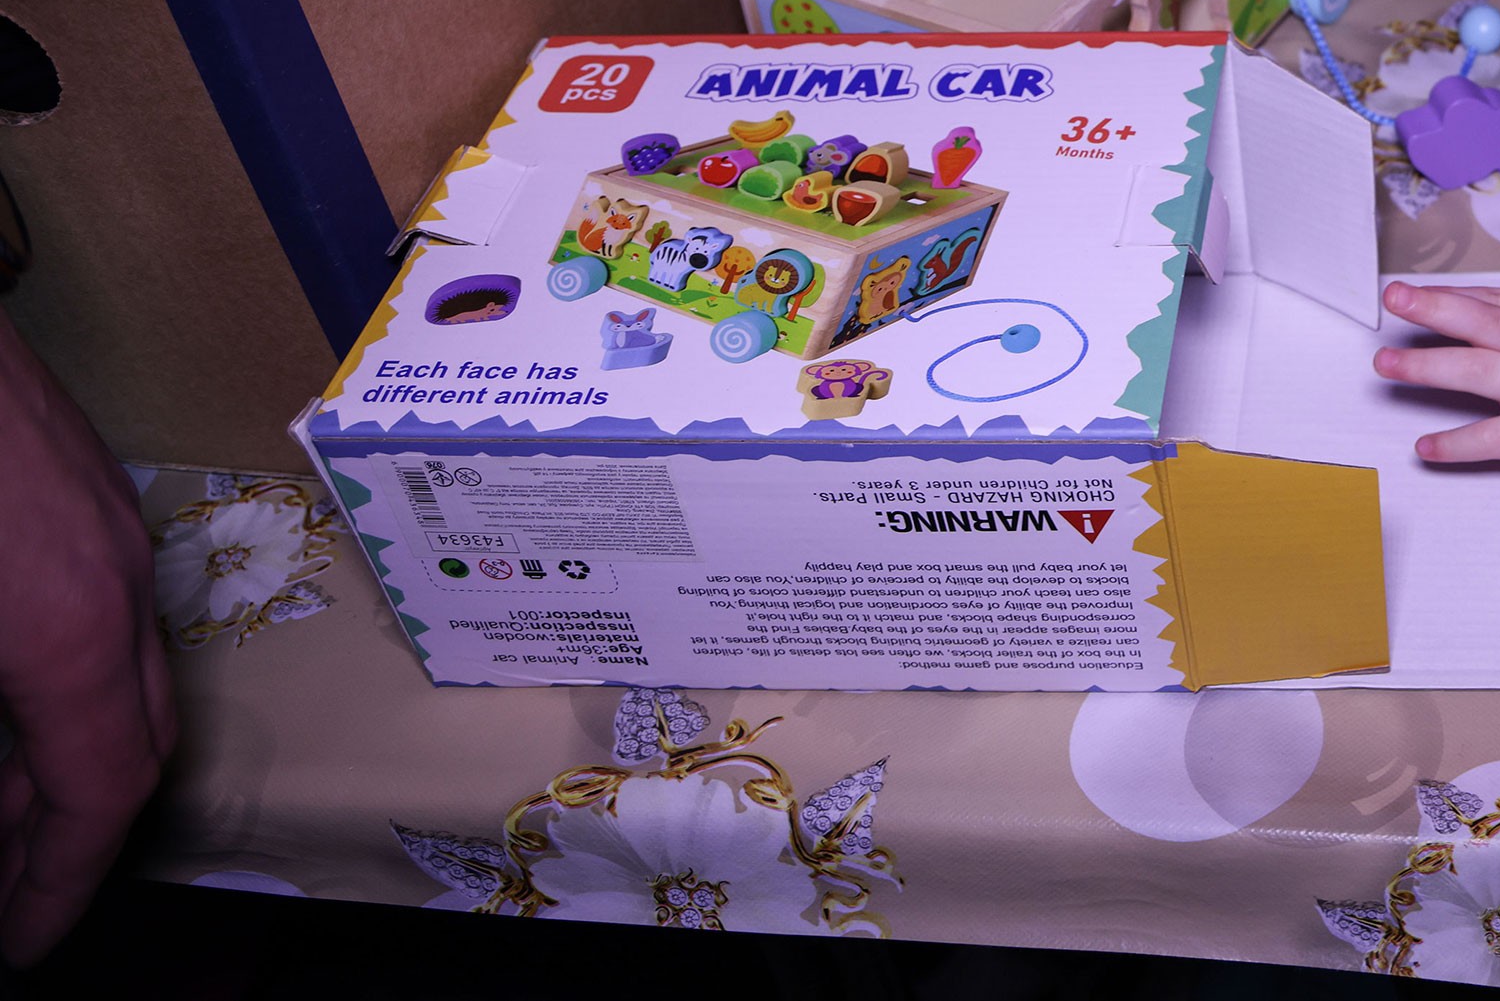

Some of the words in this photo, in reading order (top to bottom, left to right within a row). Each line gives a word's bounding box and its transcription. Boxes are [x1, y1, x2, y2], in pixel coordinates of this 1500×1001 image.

[570, 63, 630, 87] 20
[688, 64, 917, 101] ANIMAL
[931, 64, 1051, 101] CAR
[560, 88, 617, 104] pcs
[1061, 116, 1136, 144] 36+
[1055, 146, 1114, 160] Months
[375, 360, 449, 378] Each
[456, 361, 518, 380] face
[526, 362, 579, 380] has
[362, 385, 488, 404] different
[494, 387, 609, 405] animals
[853, 480, 903, 489] years.
[909, 482, 919, 491] 3
[926, 481, 973, 491] under
[980, 481, 1049, 490] Children
[1056, 481, 1079, 490] for
[1085, 480, 1113, 489] Not
[814, 493, 867, 504] Parts.
[874, 493, 926, 504] Small
[948, 492, 1023, 504] HAZARD
[1031, 491, 1115, 503] CHOKING
[876, 511, 1059, 533] WARNING:
[437, 534, 504, 547] F43634
[805, 563, 853, 573] happily
[857, 563, 884, 572] play
[917, 565, 942, 573] box
[988, 565, 1009, 573] the
[1013, 564, 1036, 573] pull
[1041, 563, 1074, 573] baby
[1078, 563, 1107, 571] your
[735, 576, 762, 584] also
[852, 577, 864, 586] of
[868, 576, 925, 585] perceive
[946, 576, 983, 586] ability
[988, 578, 1009, 586] the
[1013, 576, 1066, 586] develop
[1087, 577, 1130, 585] blocks
[678, 587, 730, 597] building
[734, 589, 746, 597] of
[749, 589, 789, 597] colors
[792, 589, 846, 598] different
[850, 590, 925, 598] understand
[929, 590, 942, 598] to
[945, 590, 998, 599] children
[1002, 588, 1031, 597] your
[1035, 590, 1072, 598] teach
[794, 600, 836, 610] logical
[839, 602, 864, 610] and
[868, 602, 949, 610] coordination
[952, 601, 984, 609] eyes
[989, 603, 1000, 611] of
[1005, 601, 1042, 611] ability
[1047, 603, 1068, 611] the
[1072, 601, 1133, 611] Improved
[789, 613, 819, 622] right
[823, 614, 844, 622] the
[919, 615, 943, 623] and
[948, 615, 994, 623] blocks,
[997, 614, 1038, 623] shape
[1042, 614, 1136, 623] corresponding
[772, 626, 800, 634] Find
[912, 627, 924, 635] of
[1003, 626, 1048, 634] appear
[1052, 626, 1100, 635] images
[722, 636, 769, 644] games,
[773, 636, 823, 645] through
[826, 638, 868, 646] blocks
[871, 637, 922, 646] building
[925, 638, 990, 647] geometric
[1010, 638, 1053, 647] variety
[1069, 639, 1112, 647] realize
[748, 649, 771, 657] life,
[774, 649, 786, 657] of
[889, 650, 921, 658] often
[948, 650, 993, 658] blocks,
[1037, 651, 1058, 659] the
[1062, 651, 1074, 659] of
[523, 656, 579, 665] Animal
[955, 661, 991, 669] game
[899, 662, 951, 670] method:
